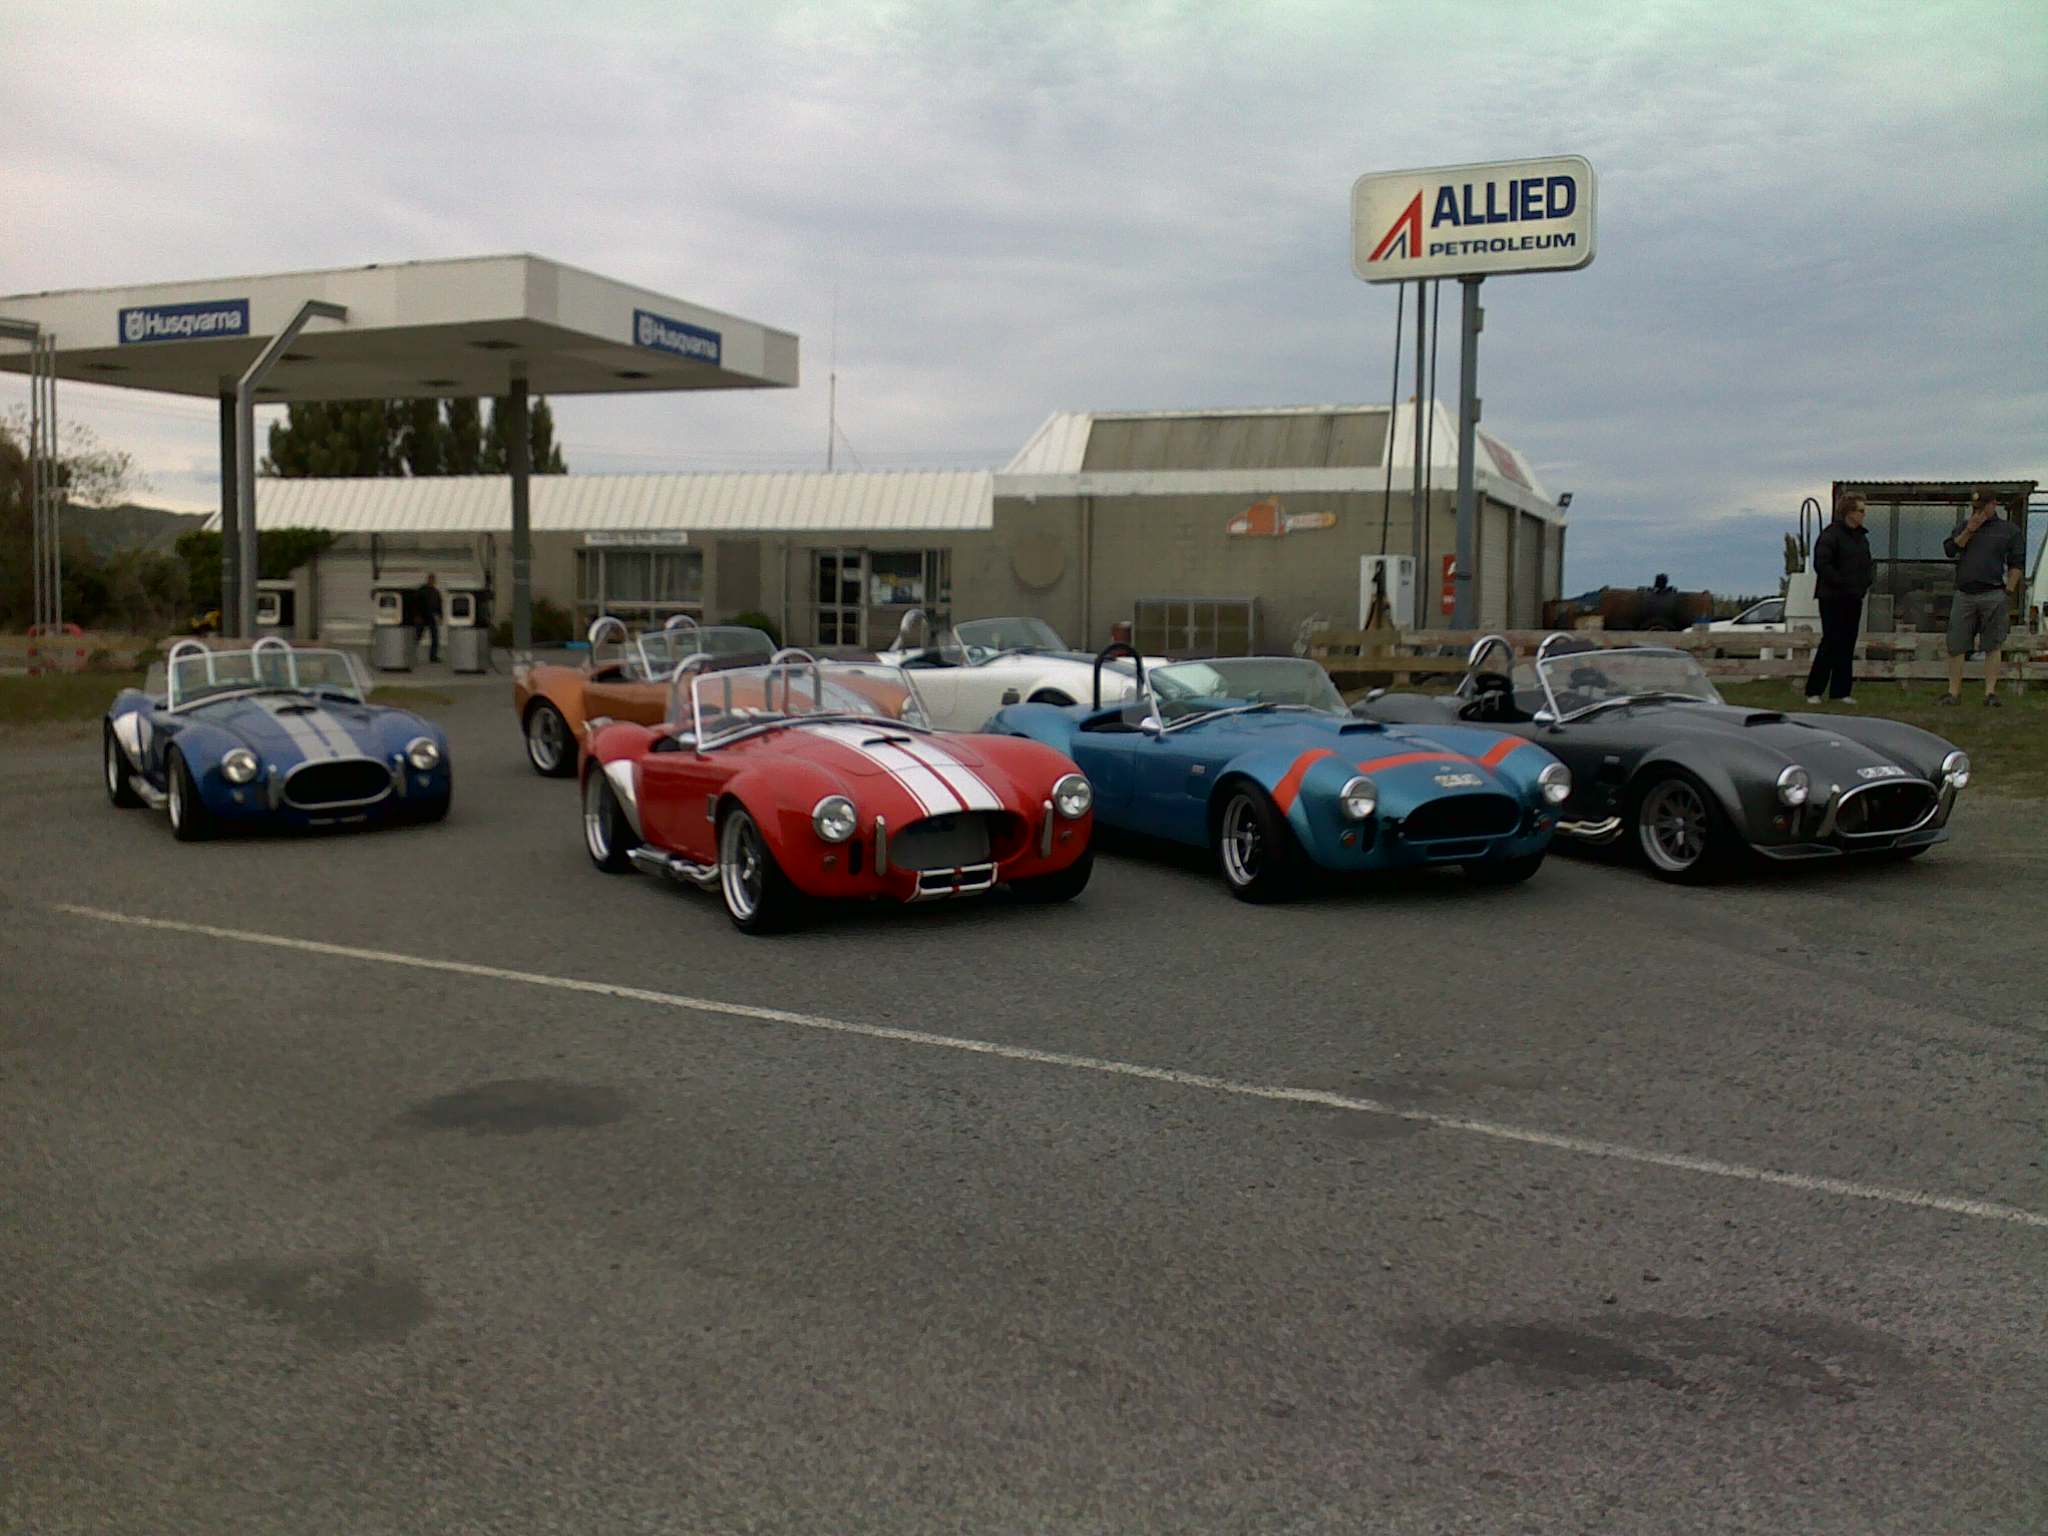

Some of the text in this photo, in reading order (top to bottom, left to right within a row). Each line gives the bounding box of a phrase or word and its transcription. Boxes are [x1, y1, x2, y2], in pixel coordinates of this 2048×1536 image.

[1430, 175, 1577, 228] ALLIED
[1429, 232, 1576, 257] PETROLEUM
[145, 310, 242, 336] Husqvarna
[656, 321, 718, 359] Husqvarna
